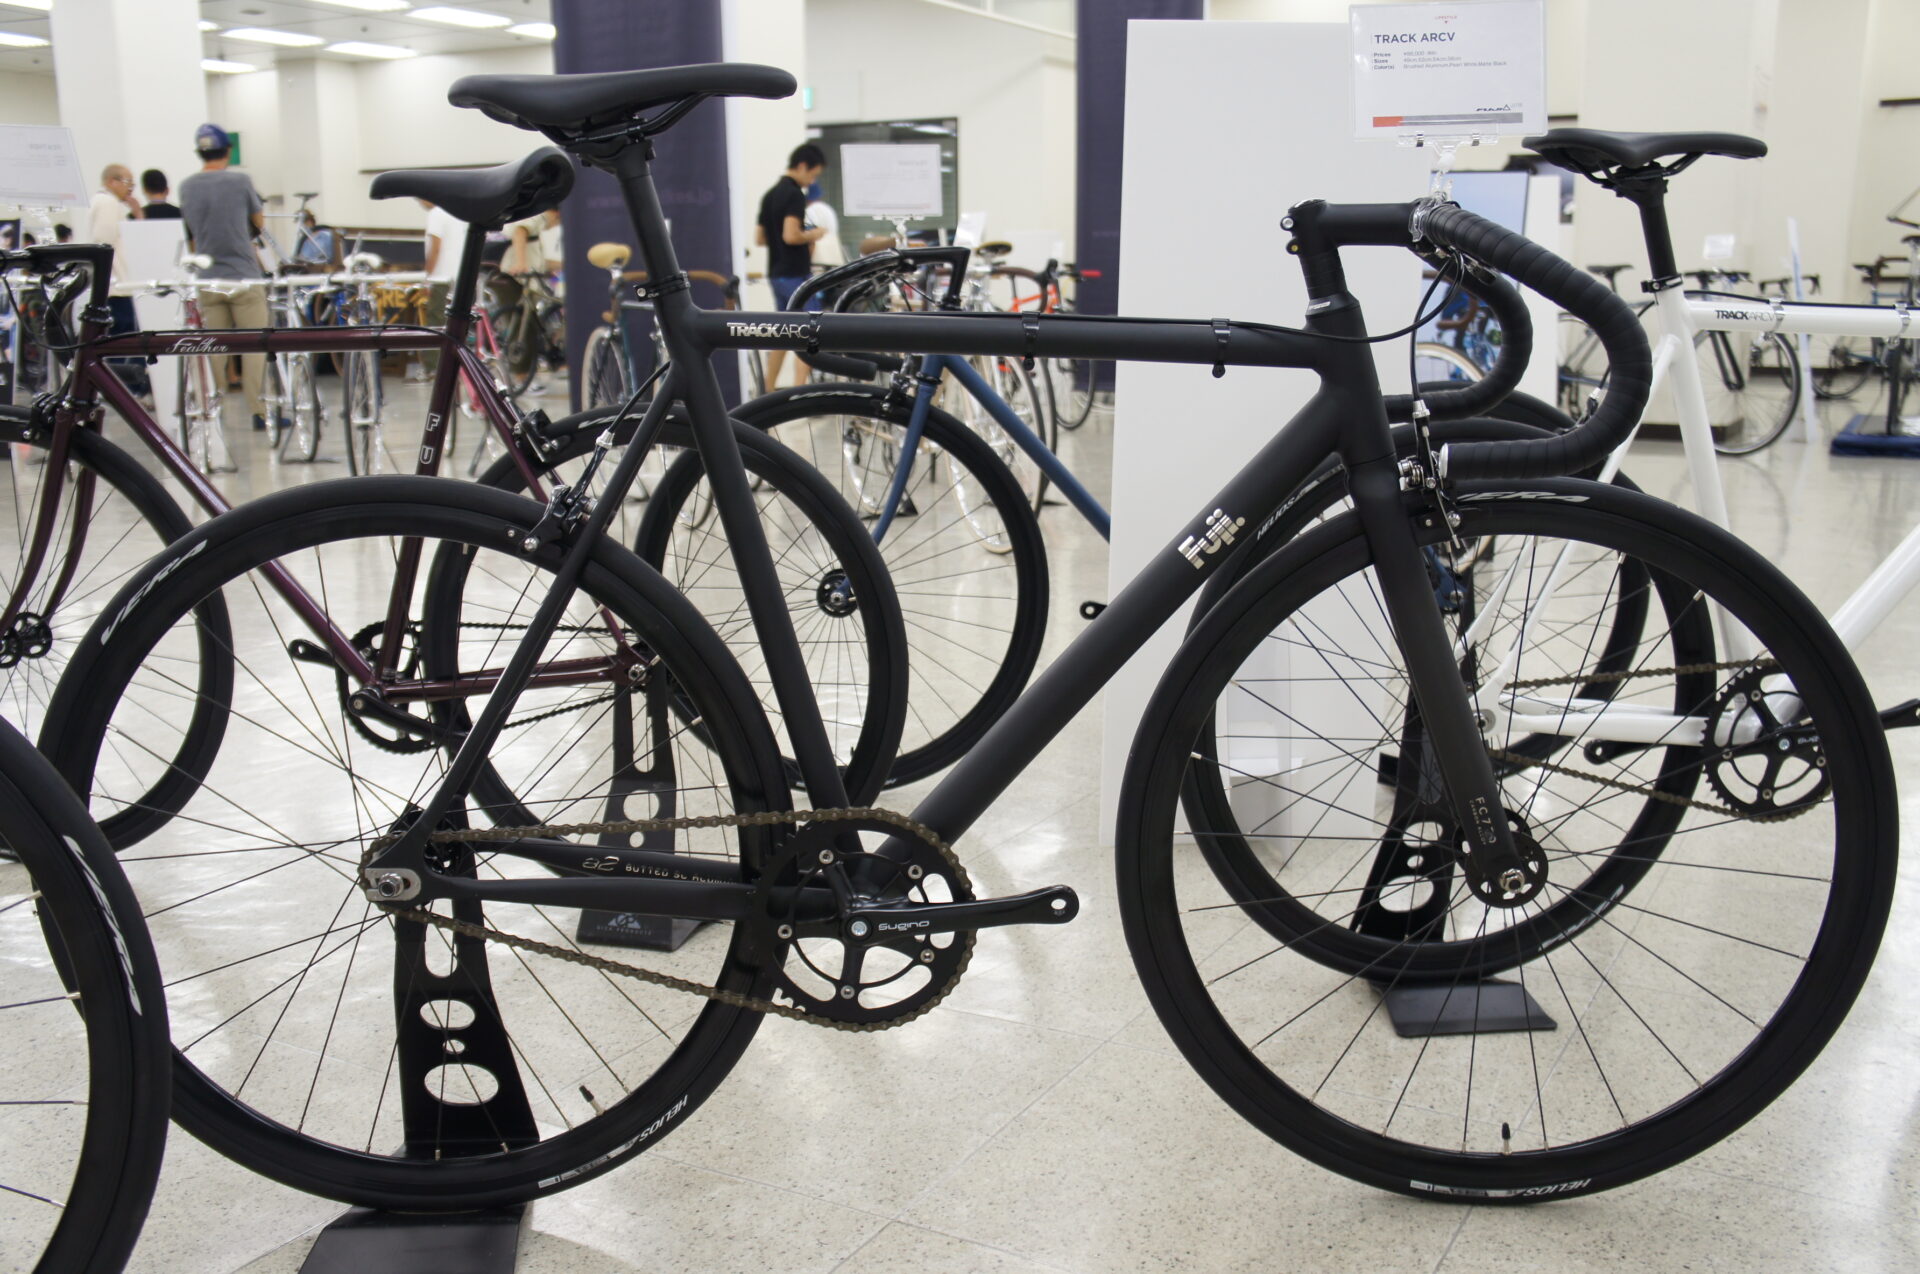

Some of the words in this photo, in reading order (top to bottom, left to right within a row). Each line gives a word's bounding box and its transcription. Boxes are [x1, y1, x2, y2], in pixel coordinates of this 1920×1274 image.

[1374, 33, 1417, 44] TRACK
[1420, 32, 1456, 43] ARCV
[637, 1094, 689, 1142] HELIOS
[1523, 1178, 1592, 1197] HELIOS
